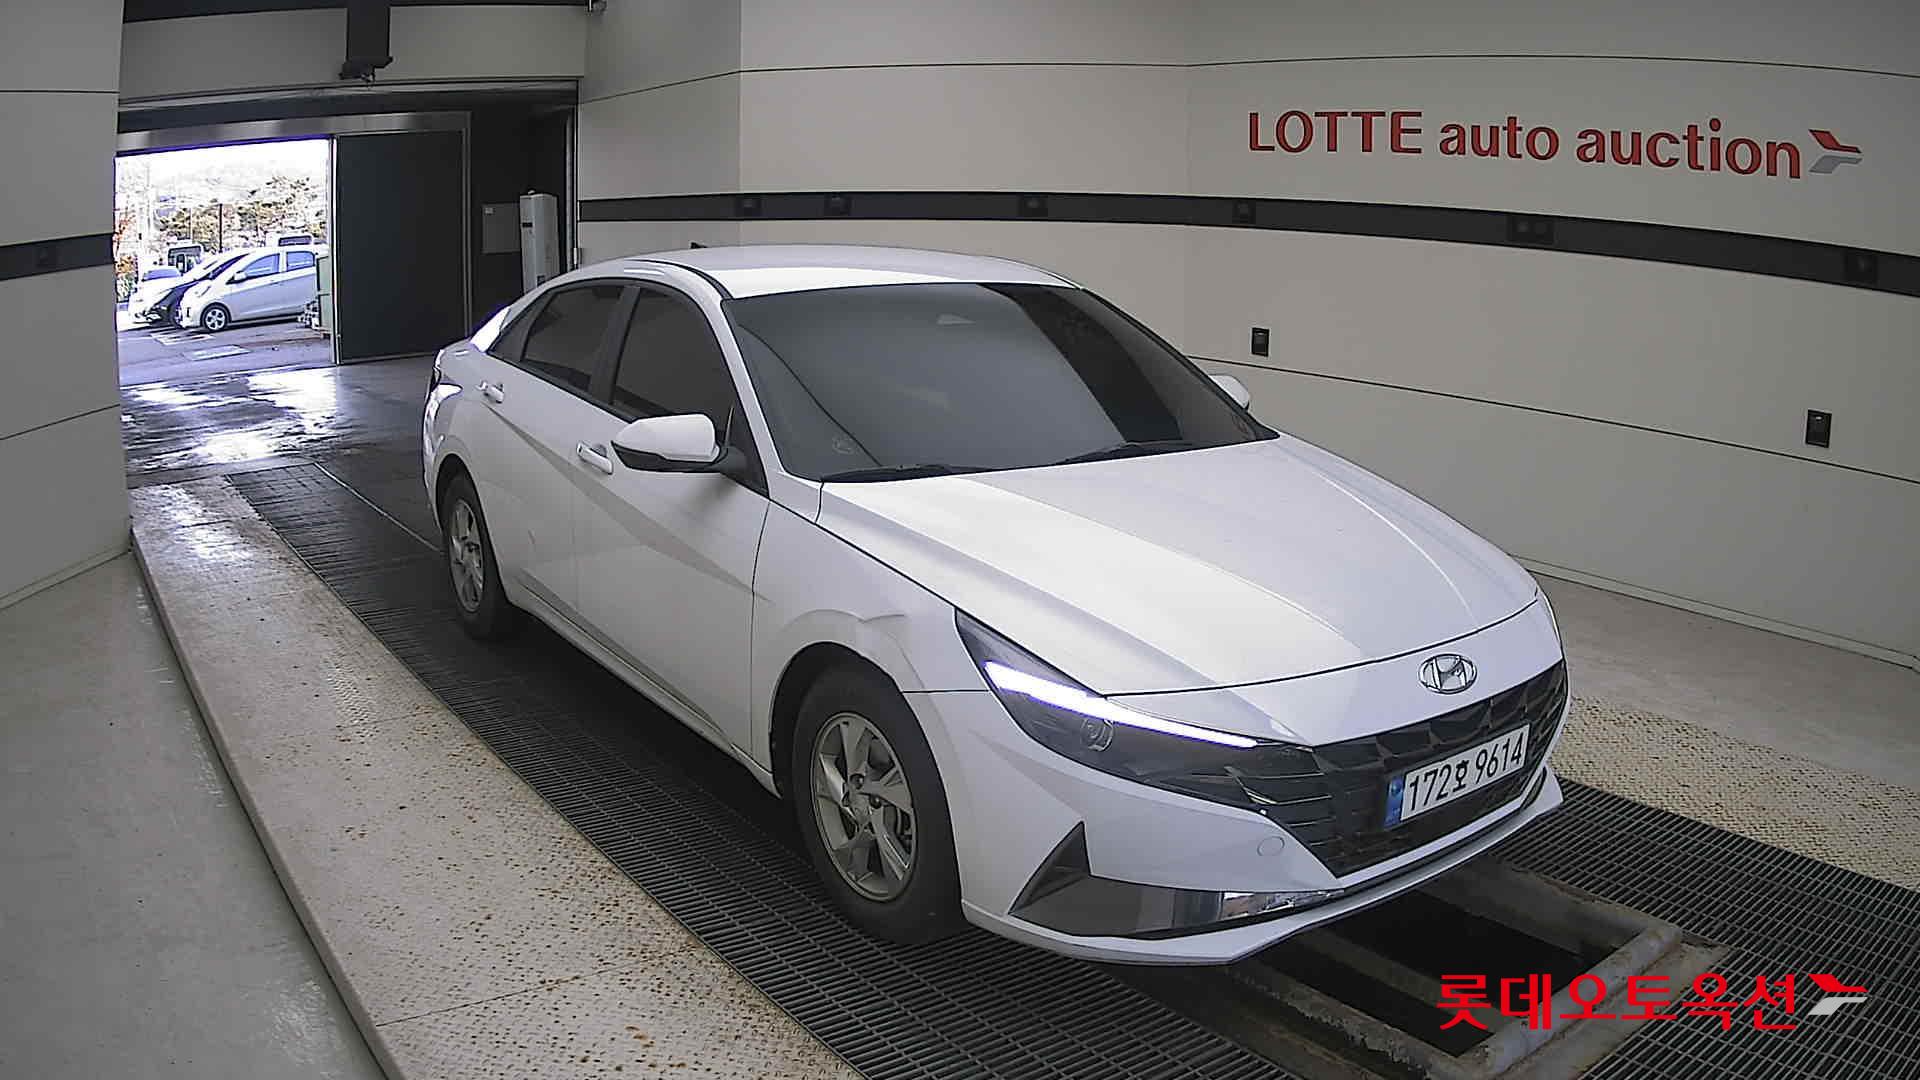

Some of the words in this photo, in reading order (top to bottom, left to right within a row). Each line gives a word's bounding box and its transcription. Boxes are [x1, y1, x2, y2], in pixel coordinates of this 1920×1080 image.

[1248, 110, 1423, 154] LOTTE
[1439, 115, 1560, 161] auto
[1575, 117, 1801, 180] auction
[1409, 759, 1470, 812] 172호
[1475, 731, 1525, 784] 9614
